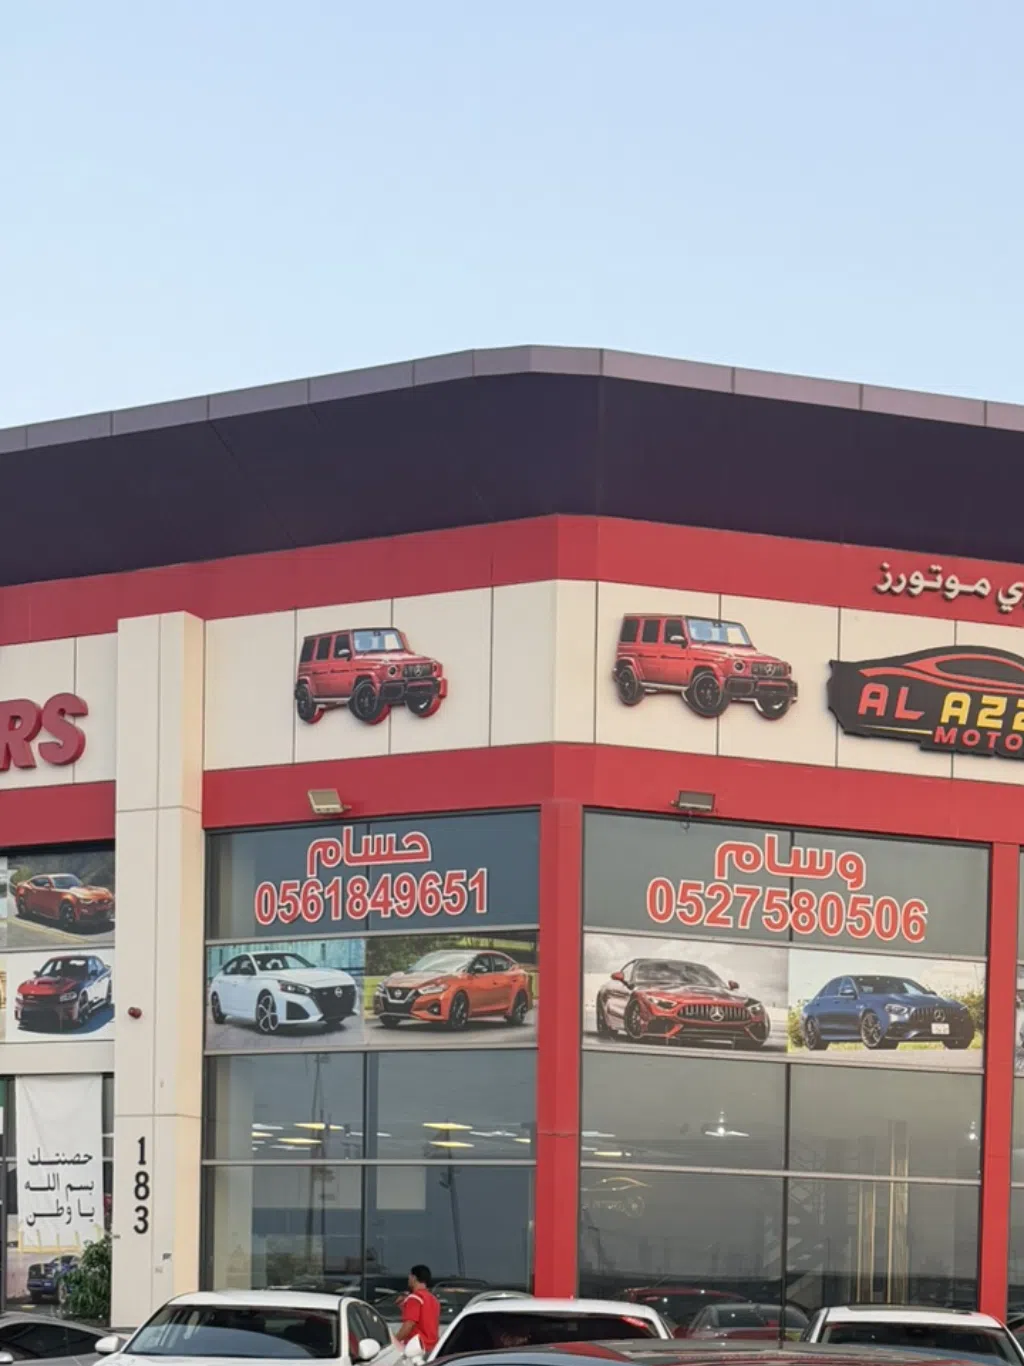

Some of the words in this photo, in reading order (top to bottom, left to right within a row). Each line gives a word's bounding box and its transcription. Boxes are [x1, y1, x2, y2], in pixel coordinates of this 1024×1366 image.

[875, 562, 992, 600] موتورز
[858, 683, 924, 721] AL
[307, 826, 431, 878] حسام
[714, 833, 866, 891] وسام
[254, 867, 487, 925] 0561849651
[646, 877, 928, 943] 0527580506
[24, 1172, 60, 1191] الله
[65, 1180, 94, 1202] بسم
[26, 1198, 72, 1226] وطن
[78, 1198, 95, 1222] يا
